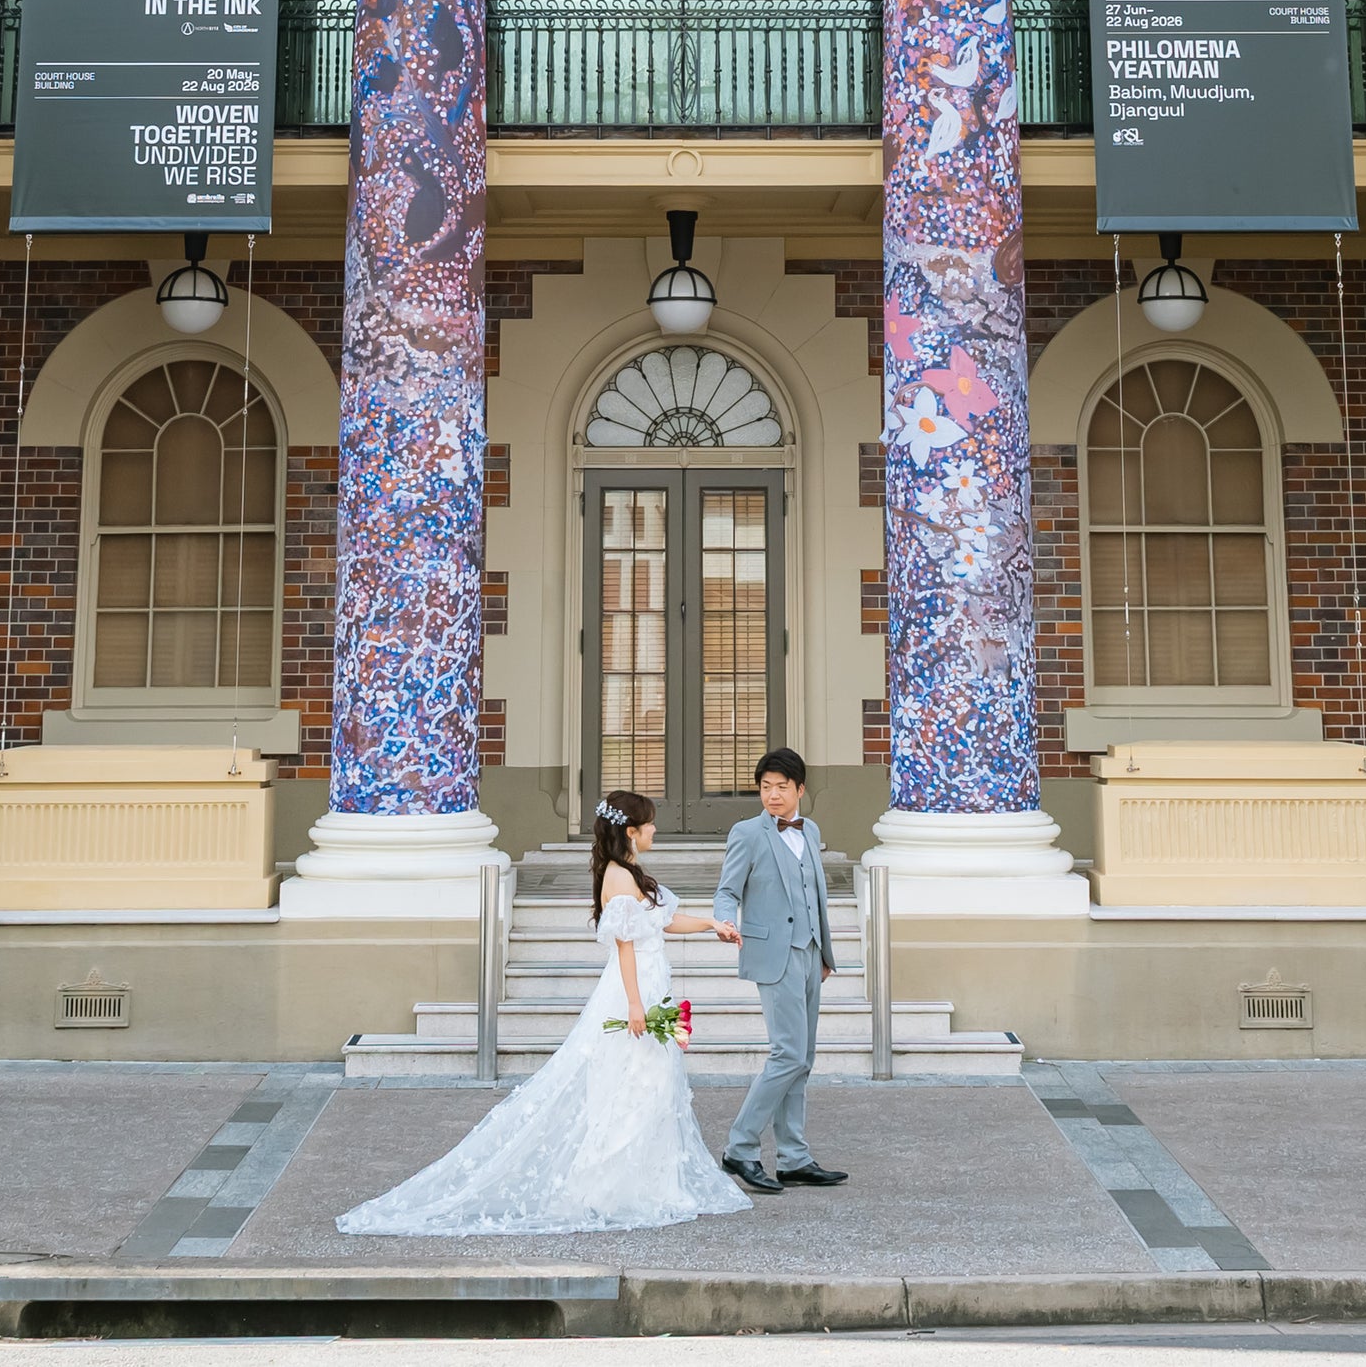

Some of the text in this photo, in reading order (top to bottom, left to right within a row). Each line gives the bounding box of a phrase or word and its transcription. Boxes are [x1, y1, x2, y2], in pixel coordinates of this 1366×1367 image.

[1105, 5, 1121, 15] 27
[1269, 7, 1329, 16] COURT HOUSE
[1106, 16, 1183, 29] 22 Aug 2026
[1290, 16, 1330, 25] BUILDING
[1106, 40, 1241, 59] PHILOMENA
[34, 72, 95, 81] COURT HOUSE
[207, 69, 224, 80] 20
[1108, 60, 1219, 79] YEATMAN
[34, 81, 75, 90] BUILDING
[182, 81, 260, 93] 22 Aug 2026
[1109, 85, 1255, 102] Babim, Muudjum,
[176, 105, 259, 124] WOVEN
[1109, 103, 1185, 120] Djanguul
[130, 125, 258, 144] TOGETHER:
[134, 146, 257, 165] UNDIVIDED
[164, 166, 256, 185] WE RISE
